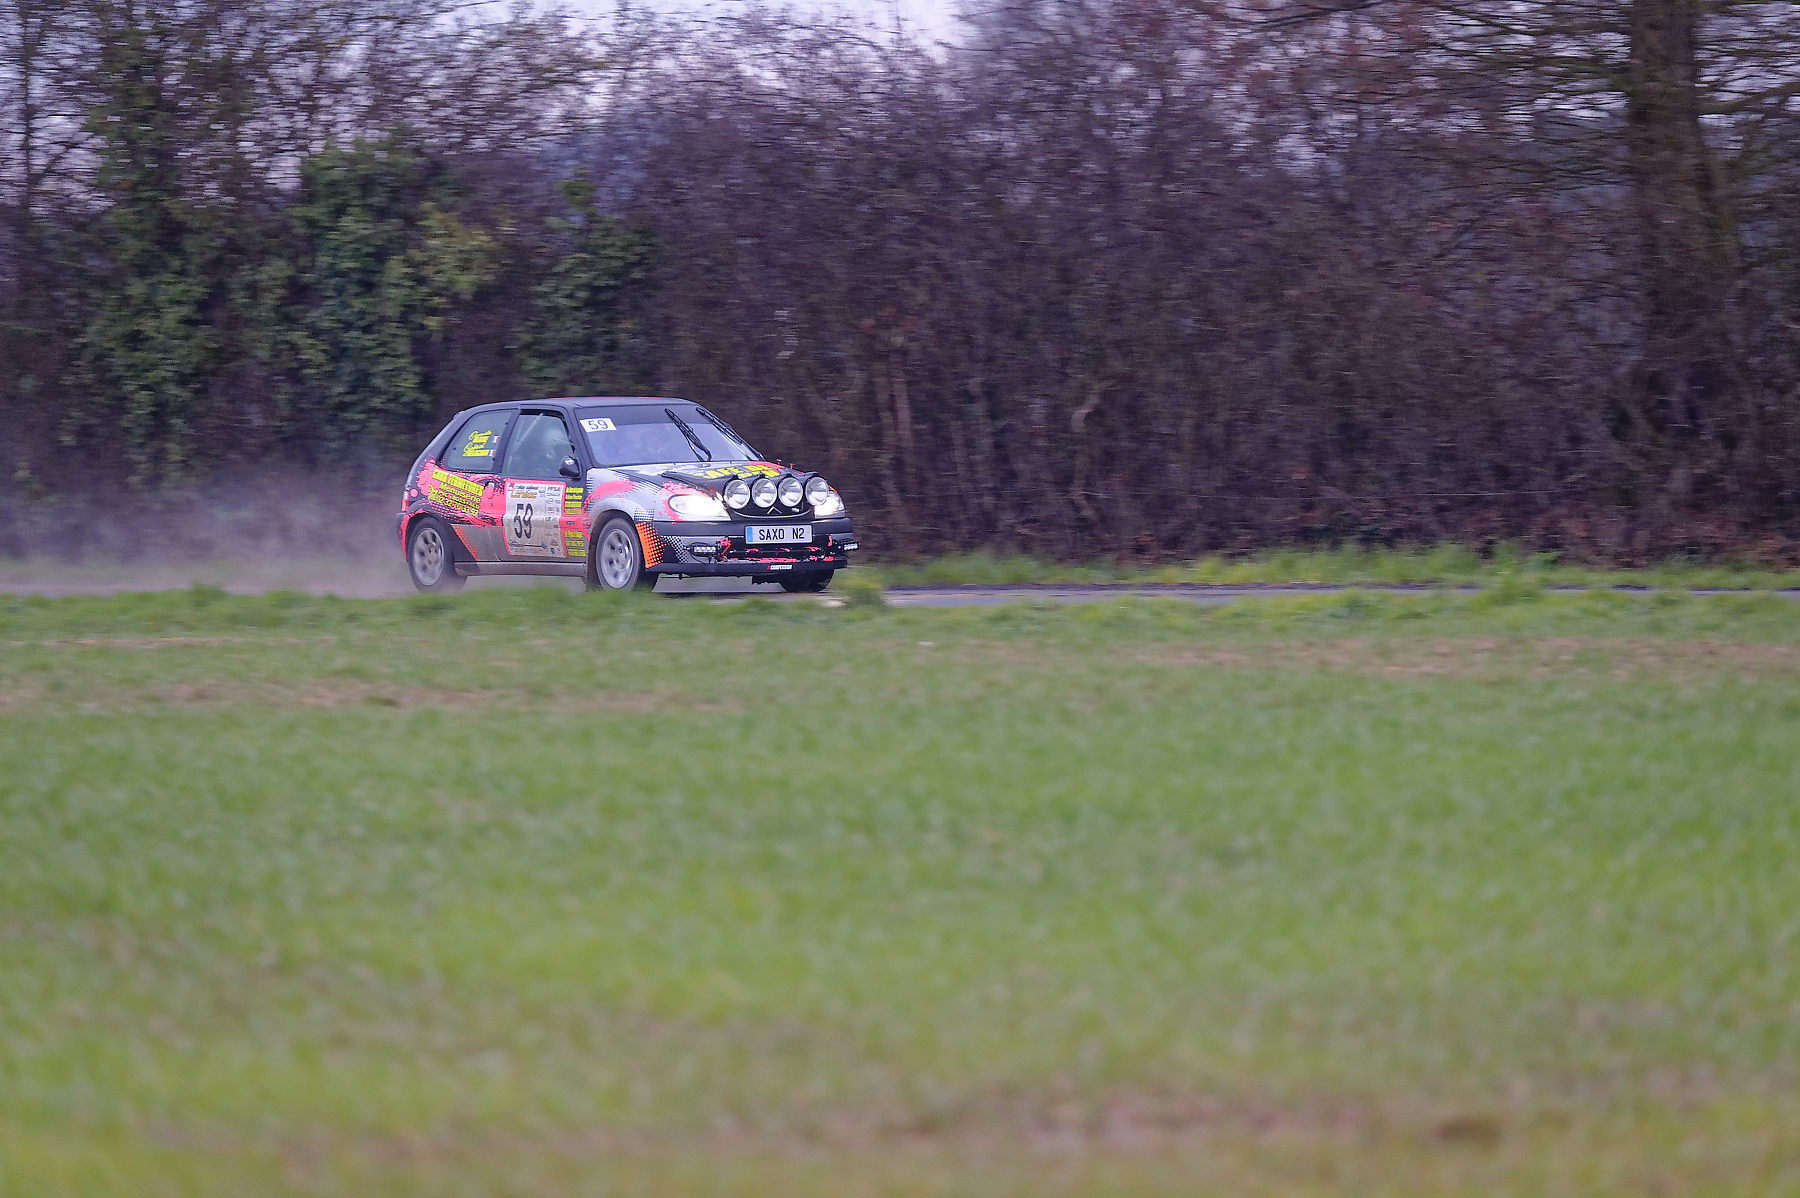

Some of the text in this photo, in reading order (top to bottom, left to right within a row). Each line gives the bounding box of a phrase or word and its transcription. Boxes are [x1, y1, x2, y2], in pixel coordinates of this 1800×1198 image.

[588, 420, 608, 430] 59
[439, 482, 481, 503] Menuiserie
[514, 503, 533, 538] 59
[759, 527, 805, 540] SAXO N2
